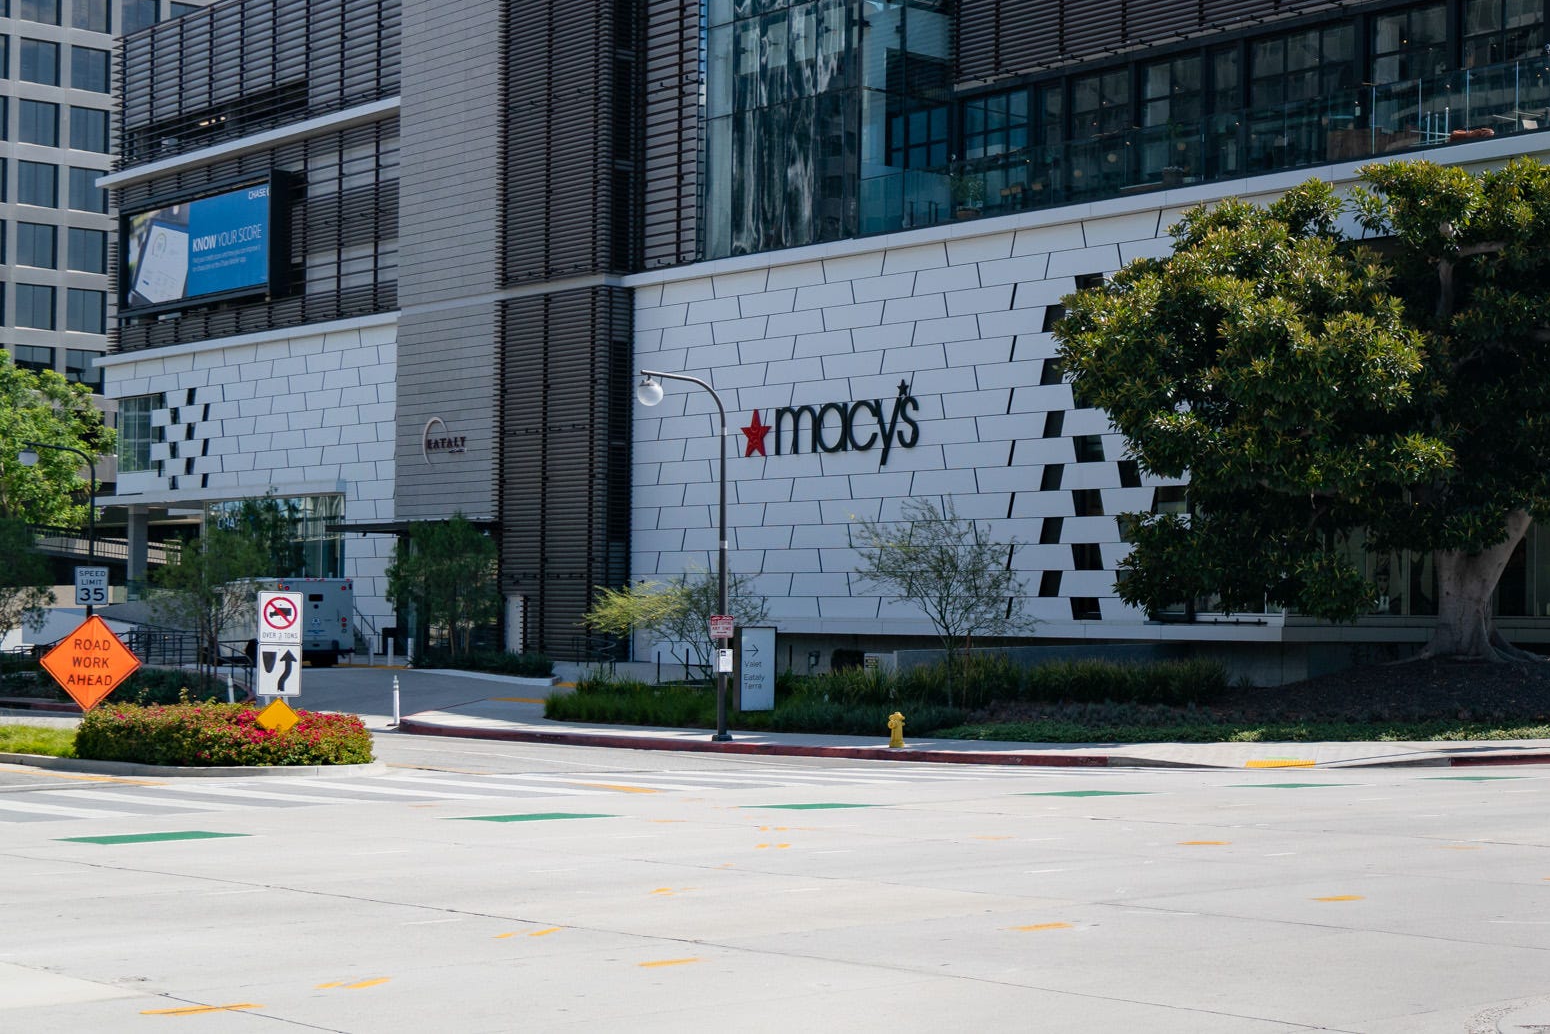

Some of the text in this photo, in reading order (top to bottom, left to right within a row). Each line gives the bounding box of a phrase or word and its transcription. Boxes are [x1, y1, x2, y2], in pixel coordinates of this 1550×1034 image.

[248, 188, 266, 200] CHASE
[193, 223, 262, 253] KNOW YOUR SCORE
[775, 379, 919, 466] macy's
[427, 436, 467, 450] EATALY
[79, 587, 105, 602] 35
[74, 639, 111, 651] ROAD
[72, 657, 110, 668] WORK
[744, 660, 762, 668] Valet
[67, 674, 113, 686] AHEAD
[744, 673, 765, 682] Eataly
